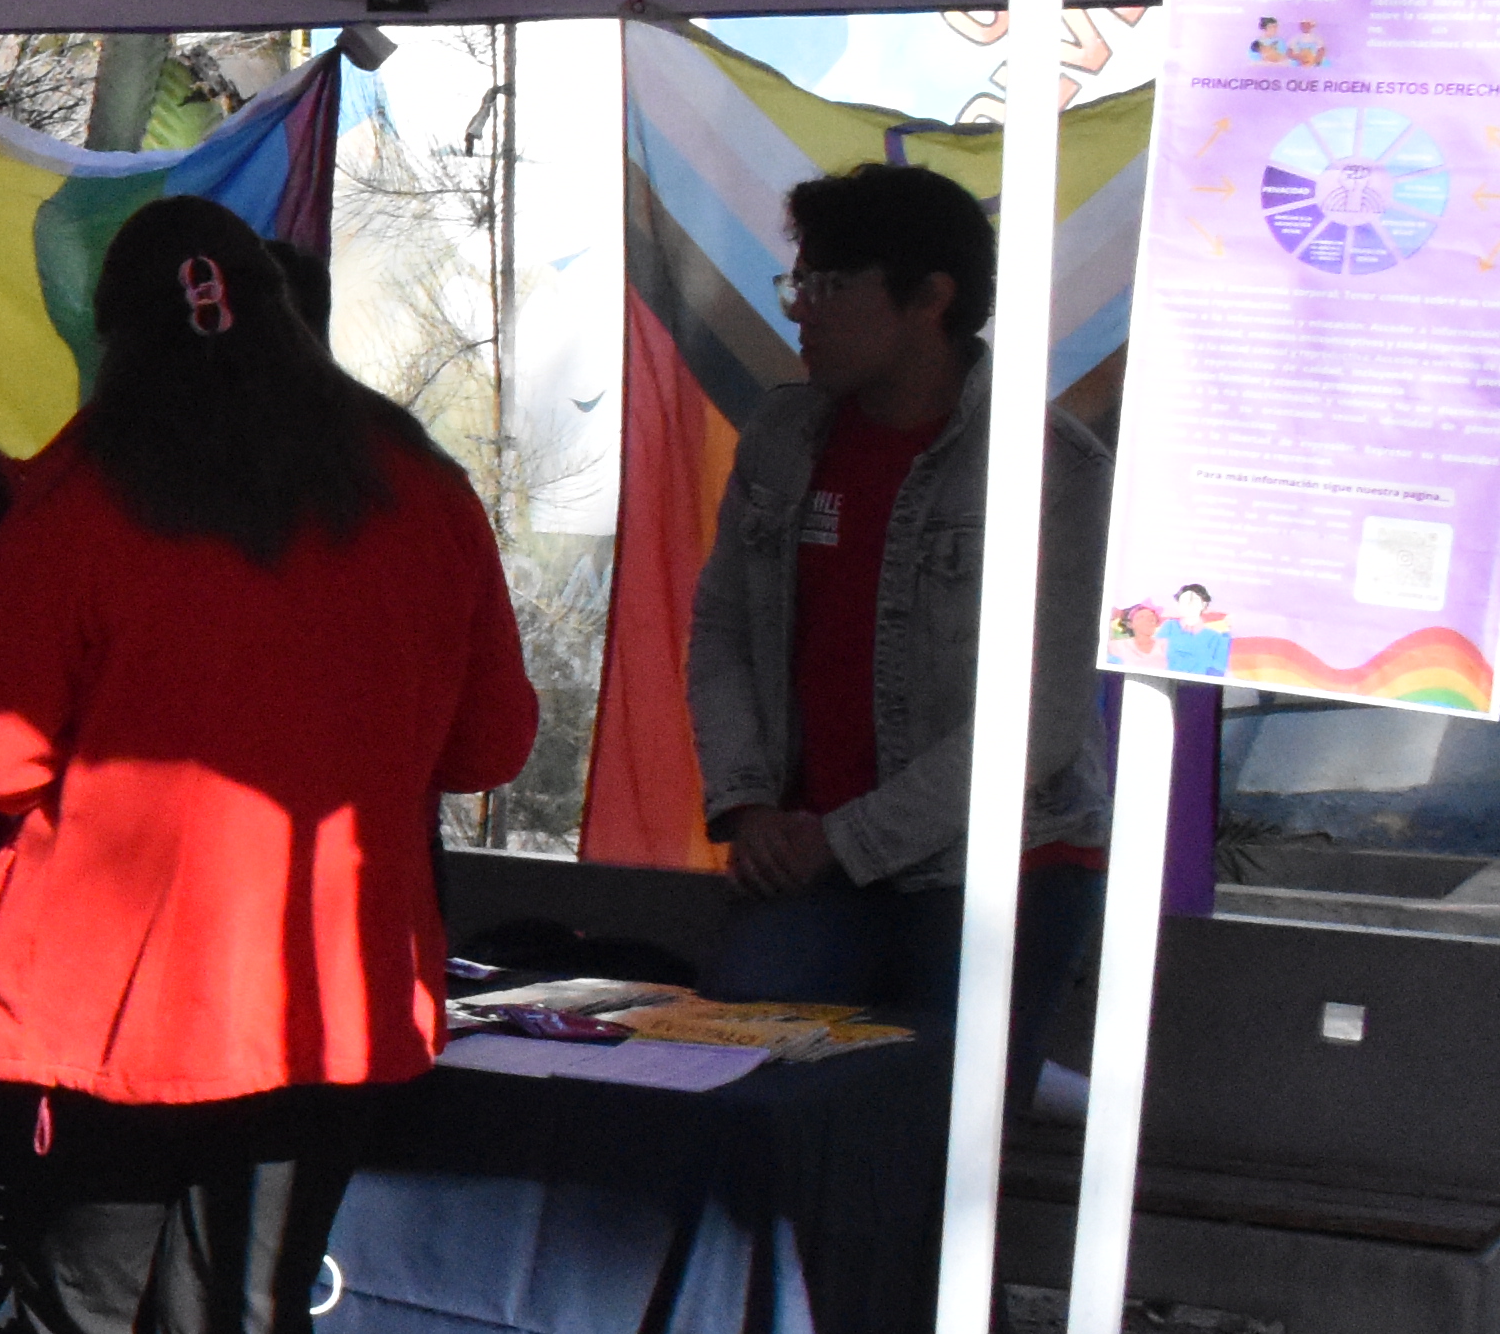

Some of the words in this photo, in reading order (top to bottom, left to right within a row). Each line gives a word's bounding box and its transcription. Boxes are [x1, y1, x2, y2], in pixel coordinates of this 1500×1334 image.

[1191, 77, 1281, 93] PRINCIPIOS
[1286, 79, 1319, 93] QUE
[1323, 80, 1371, 94] RIGEN
[1375, 80, 1430, 95] ESTOS
[1434, 82, 1500, 97] DERECH
[1196, 468, 1222, 480] Para
[1225, 471, 1249, 483] más
[1251, 474, 1320, 490] información
[1322, 481, 1353, 495] sigue
[1355, 485, 1401, 498] nuestra
